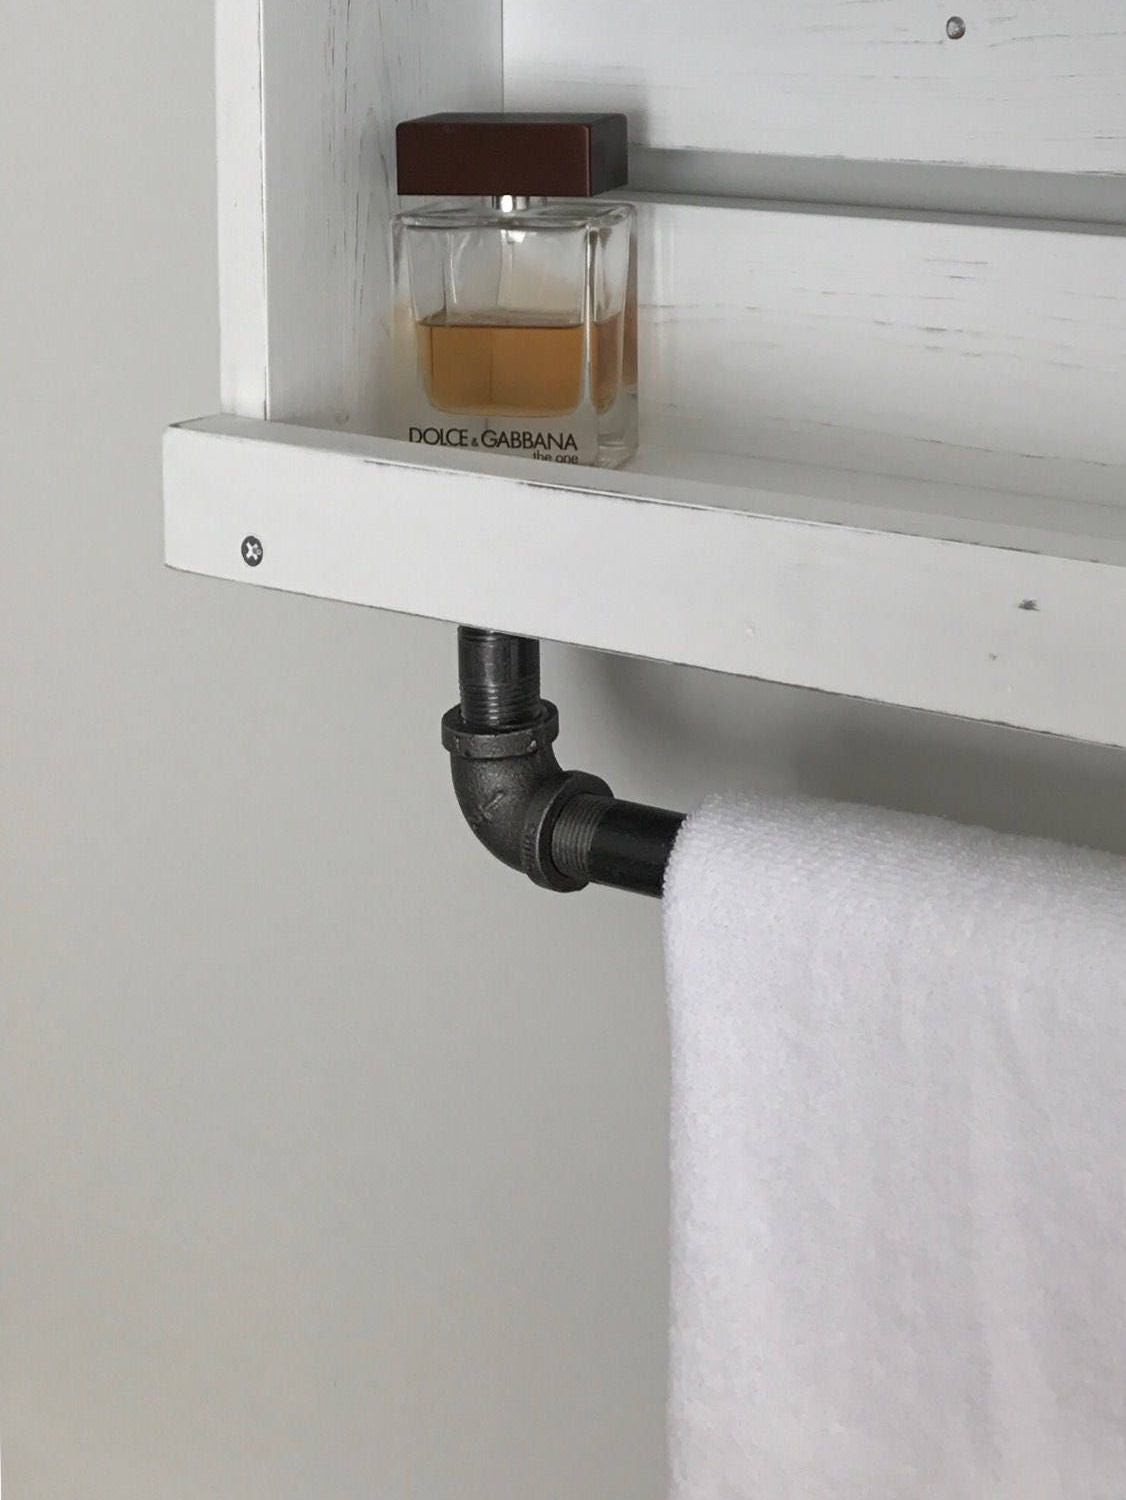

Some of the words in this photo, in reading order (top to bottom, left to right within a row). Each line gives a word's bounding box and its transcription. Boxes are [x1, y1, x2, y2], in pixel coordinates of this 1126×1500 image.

[408, 427, 468, 447] DOLCE
[471, 437, 479, 447] &
[481, 429, 578, 451] GABBANA
[533, 450, 554, 462] the
[555, 454, 579, 465] one
